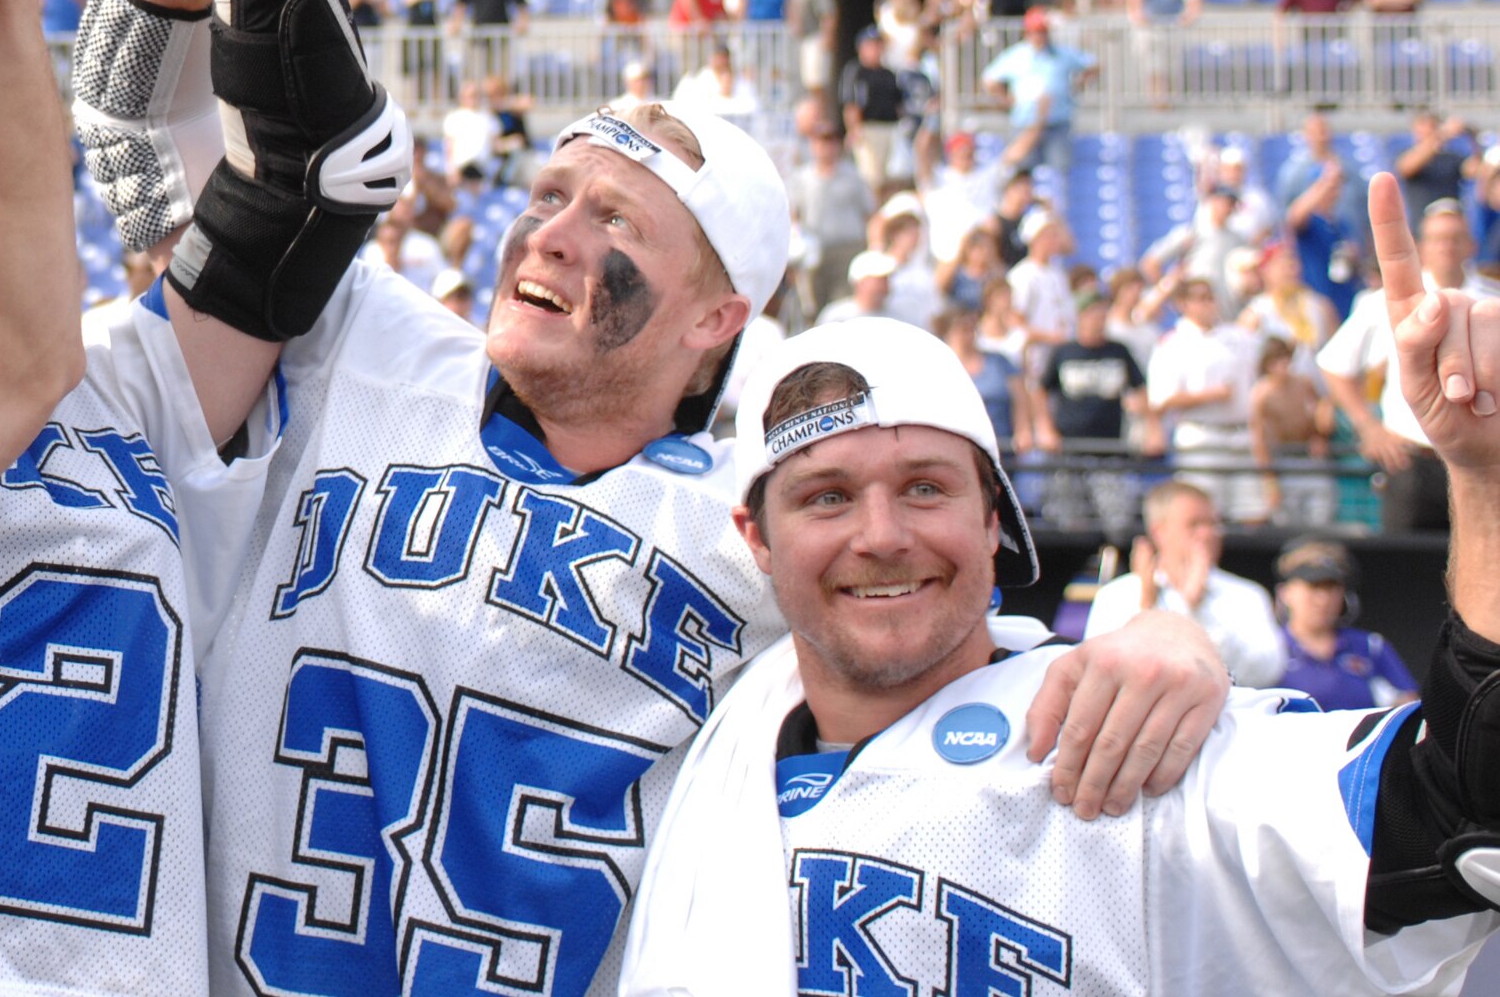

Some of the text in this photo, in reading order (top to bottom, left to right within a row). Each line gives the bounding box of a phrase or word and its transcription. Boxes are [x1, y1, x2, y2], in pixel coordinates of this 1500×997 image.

[772, 410, 855, 454] CHAMPIONS
[655, 451, 704, 469] NCAA
[269, 463, 747, 733] DUKE
[943, 731, 998, 748] NCAA
[235, 645, 673, 997] 35
